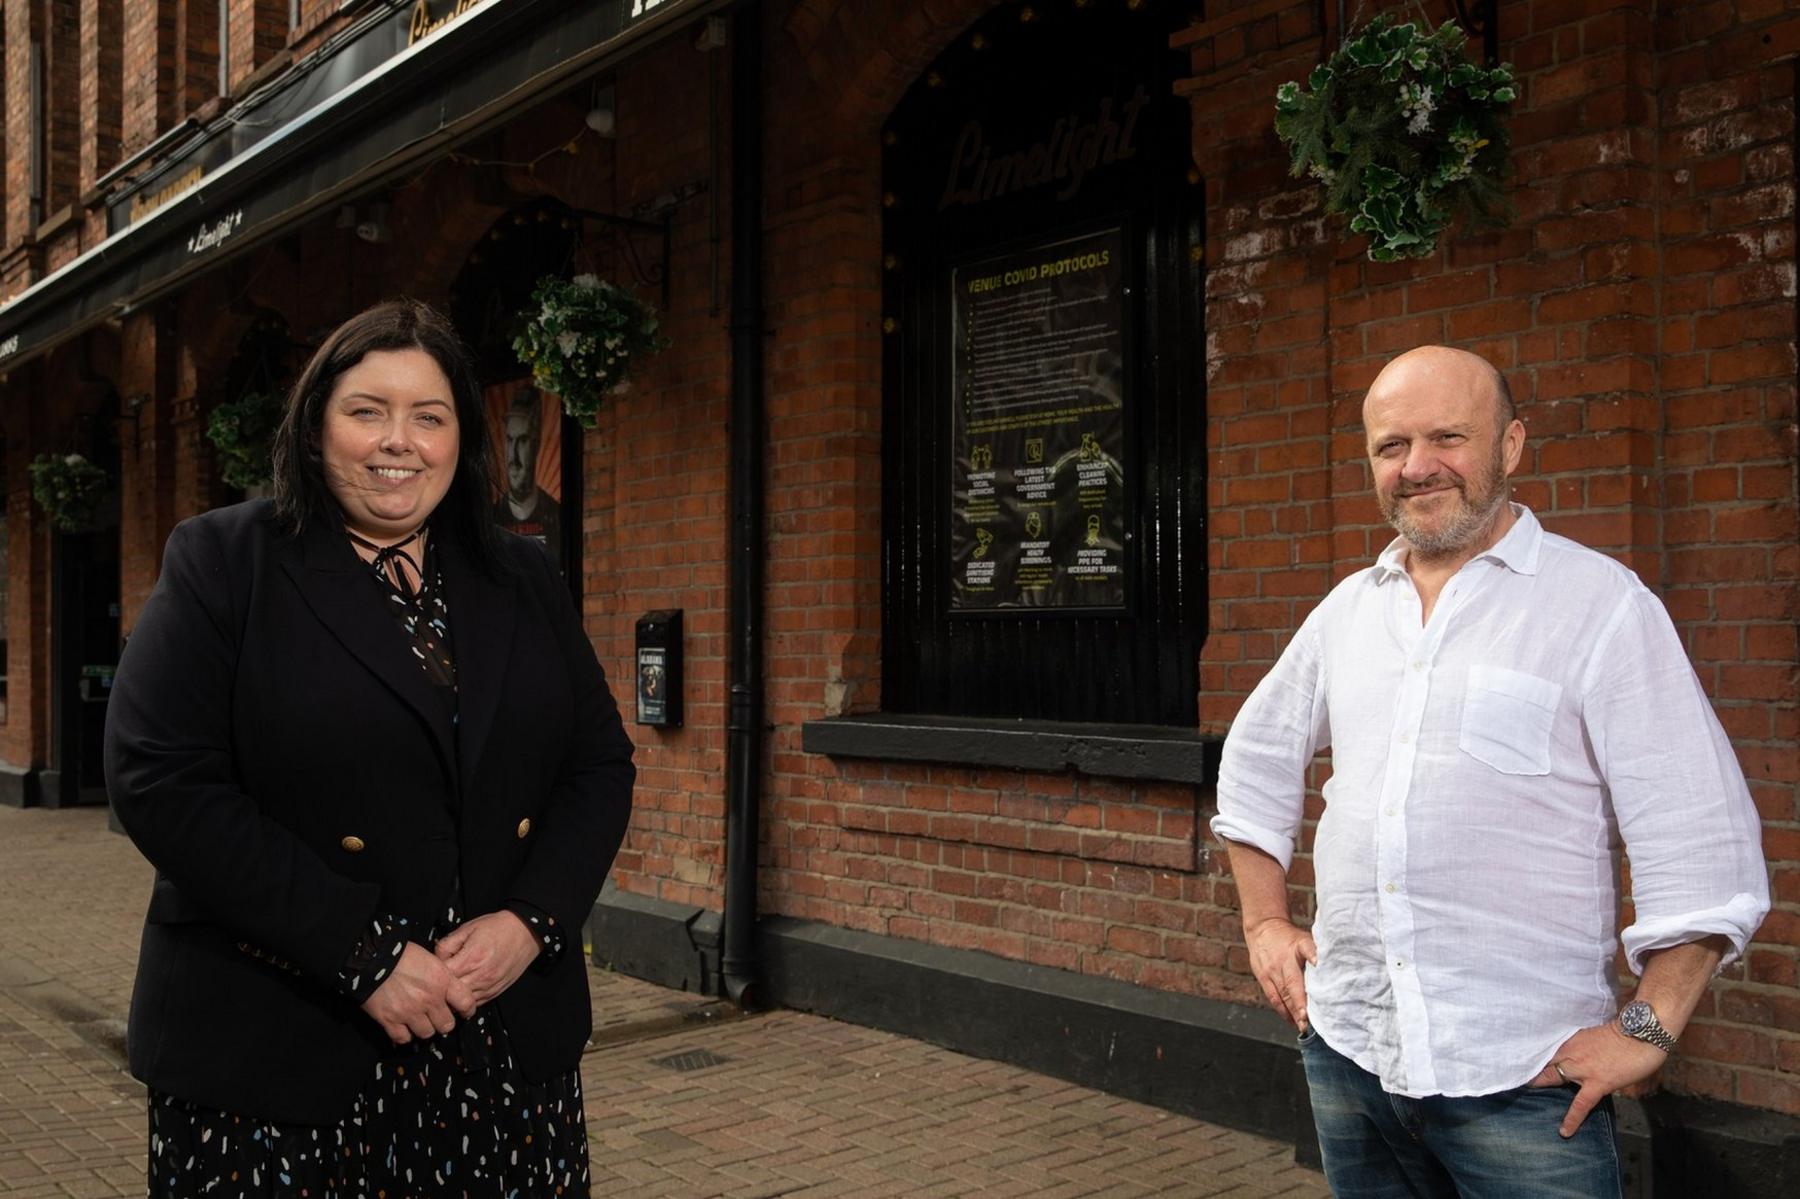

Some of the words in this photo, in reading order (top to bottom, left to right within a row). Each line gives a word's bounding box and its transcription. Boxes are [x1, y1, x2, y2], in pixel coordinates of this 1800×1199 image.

[936, 83, 1152, 214] Limelight
[193, 212, 235, 254] Limelight
[968, 273, 1003, 294] VENUE
[1004, 265, 1038, 286] COVID
[1040, 250, 1111, 279] PROTOCOLS
[1014, 467, 1044, 477] FOLLOWING
[1078, 470, 1106, 479] CLEANING
[1024, 475, 1045, 484] LATEST
[1078, 478, 1107, 487] PRACTICES
[1016, 482, 1055, 492] GOVERNMENT
[1026, 491, 1047, 499] ADVICE
[1091, 557, 1103, 565] FOR
[1067, 565, 1098, 574] NECESSARY
